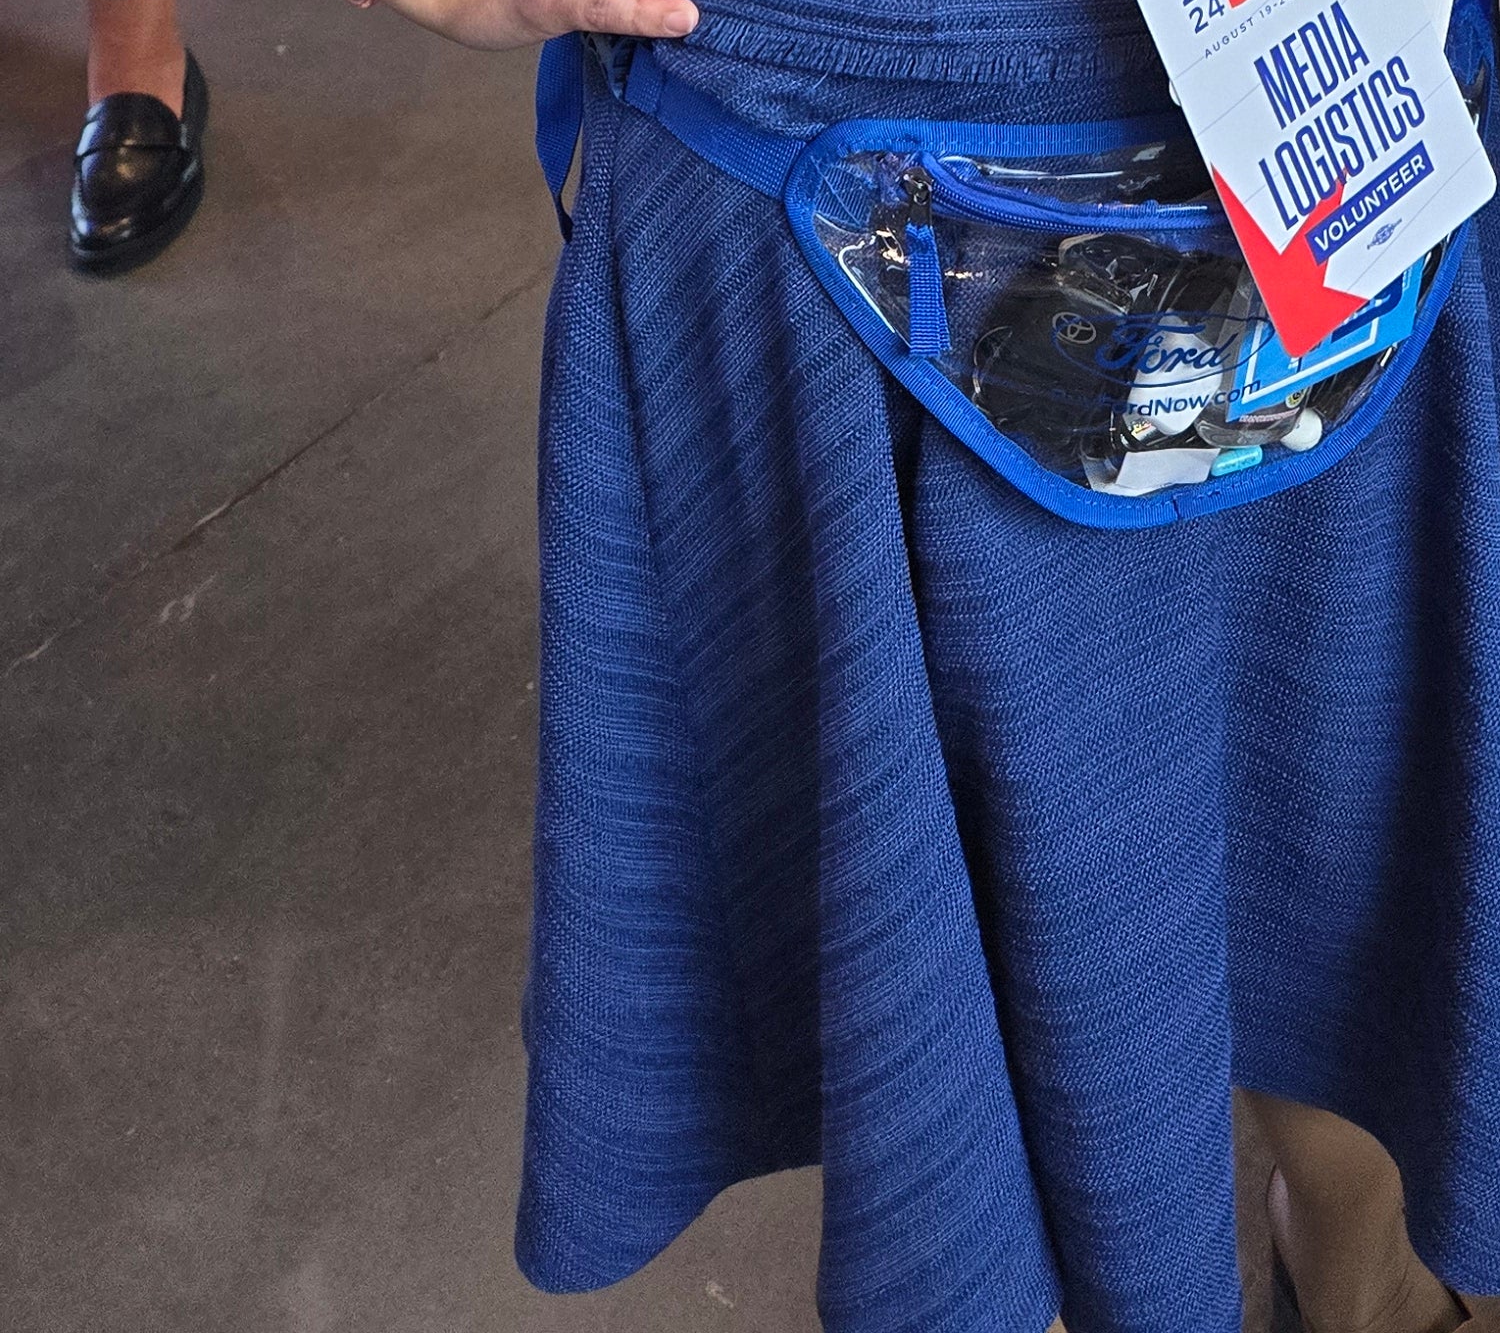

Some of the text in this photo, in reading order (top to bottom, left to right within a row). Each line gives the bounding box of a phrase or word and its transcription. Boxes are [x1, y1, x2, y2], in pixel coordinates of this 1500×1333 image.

[1204, 17, 1255, 58] AUGUST
[1253, 0, 1370, 130] MEDIA
[1258, 55, 1425, 231] LOGISTICS
[1314, 153, 1427, 252] VOLUNTEER
[1095, 322, 1238, 375] Ford
